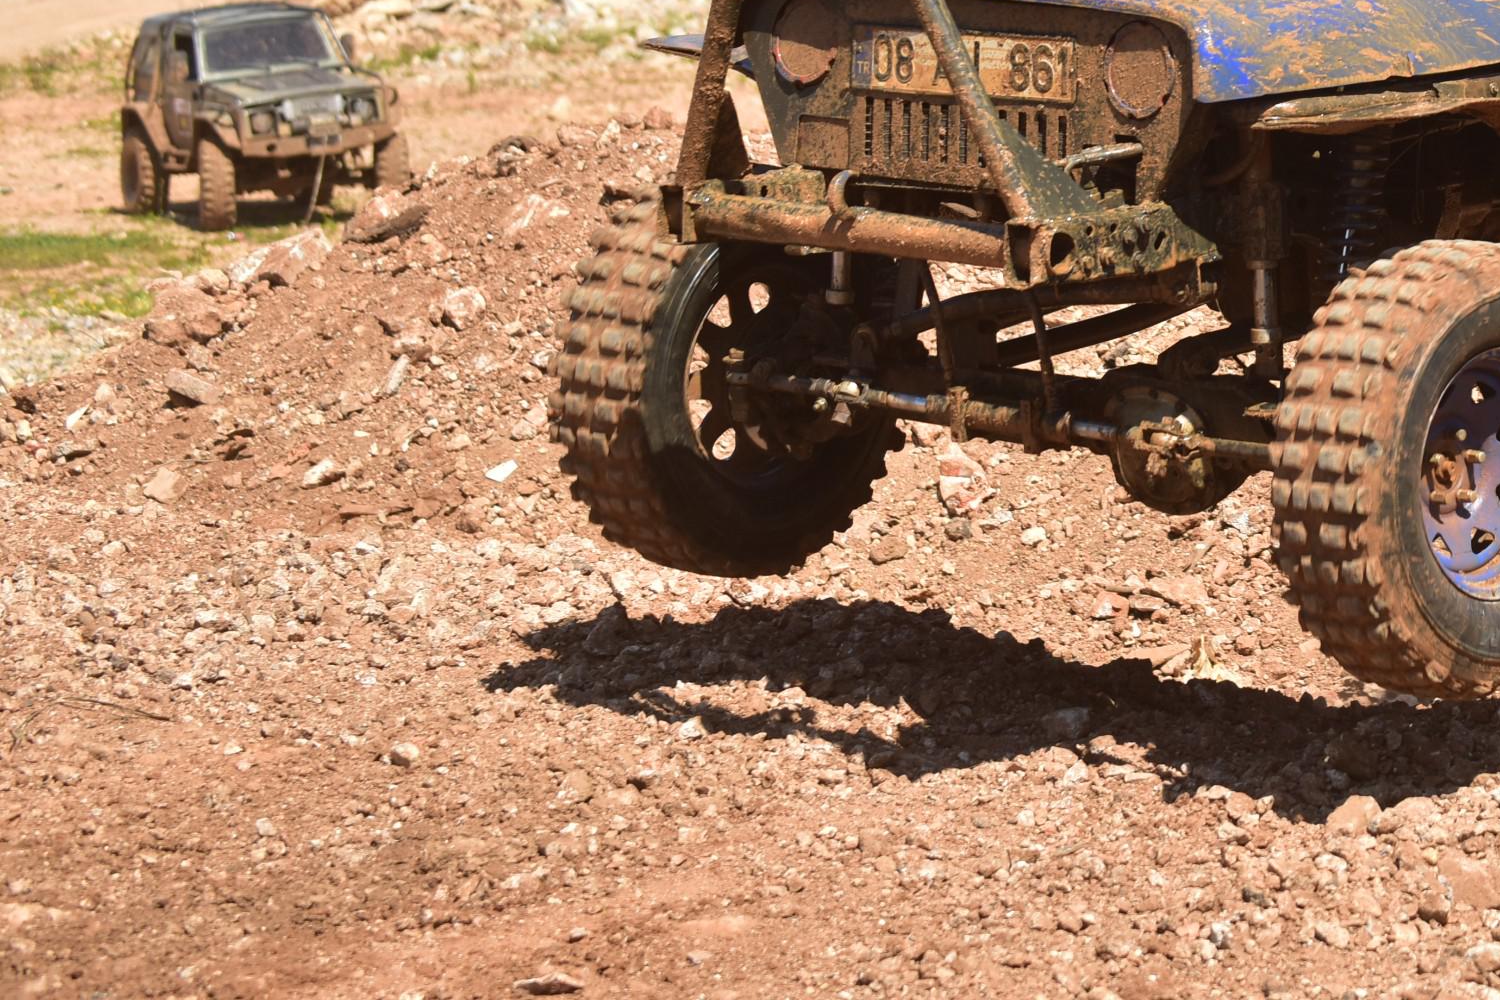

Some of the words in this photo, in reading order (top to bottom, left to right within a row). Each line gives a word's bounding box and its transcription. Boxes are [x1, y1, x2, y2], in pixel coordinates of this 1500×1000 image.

[857, 60, 870, 74] TR
[873, 33, 915, 84] 08
[1009, 43, 1068, 96] 861
